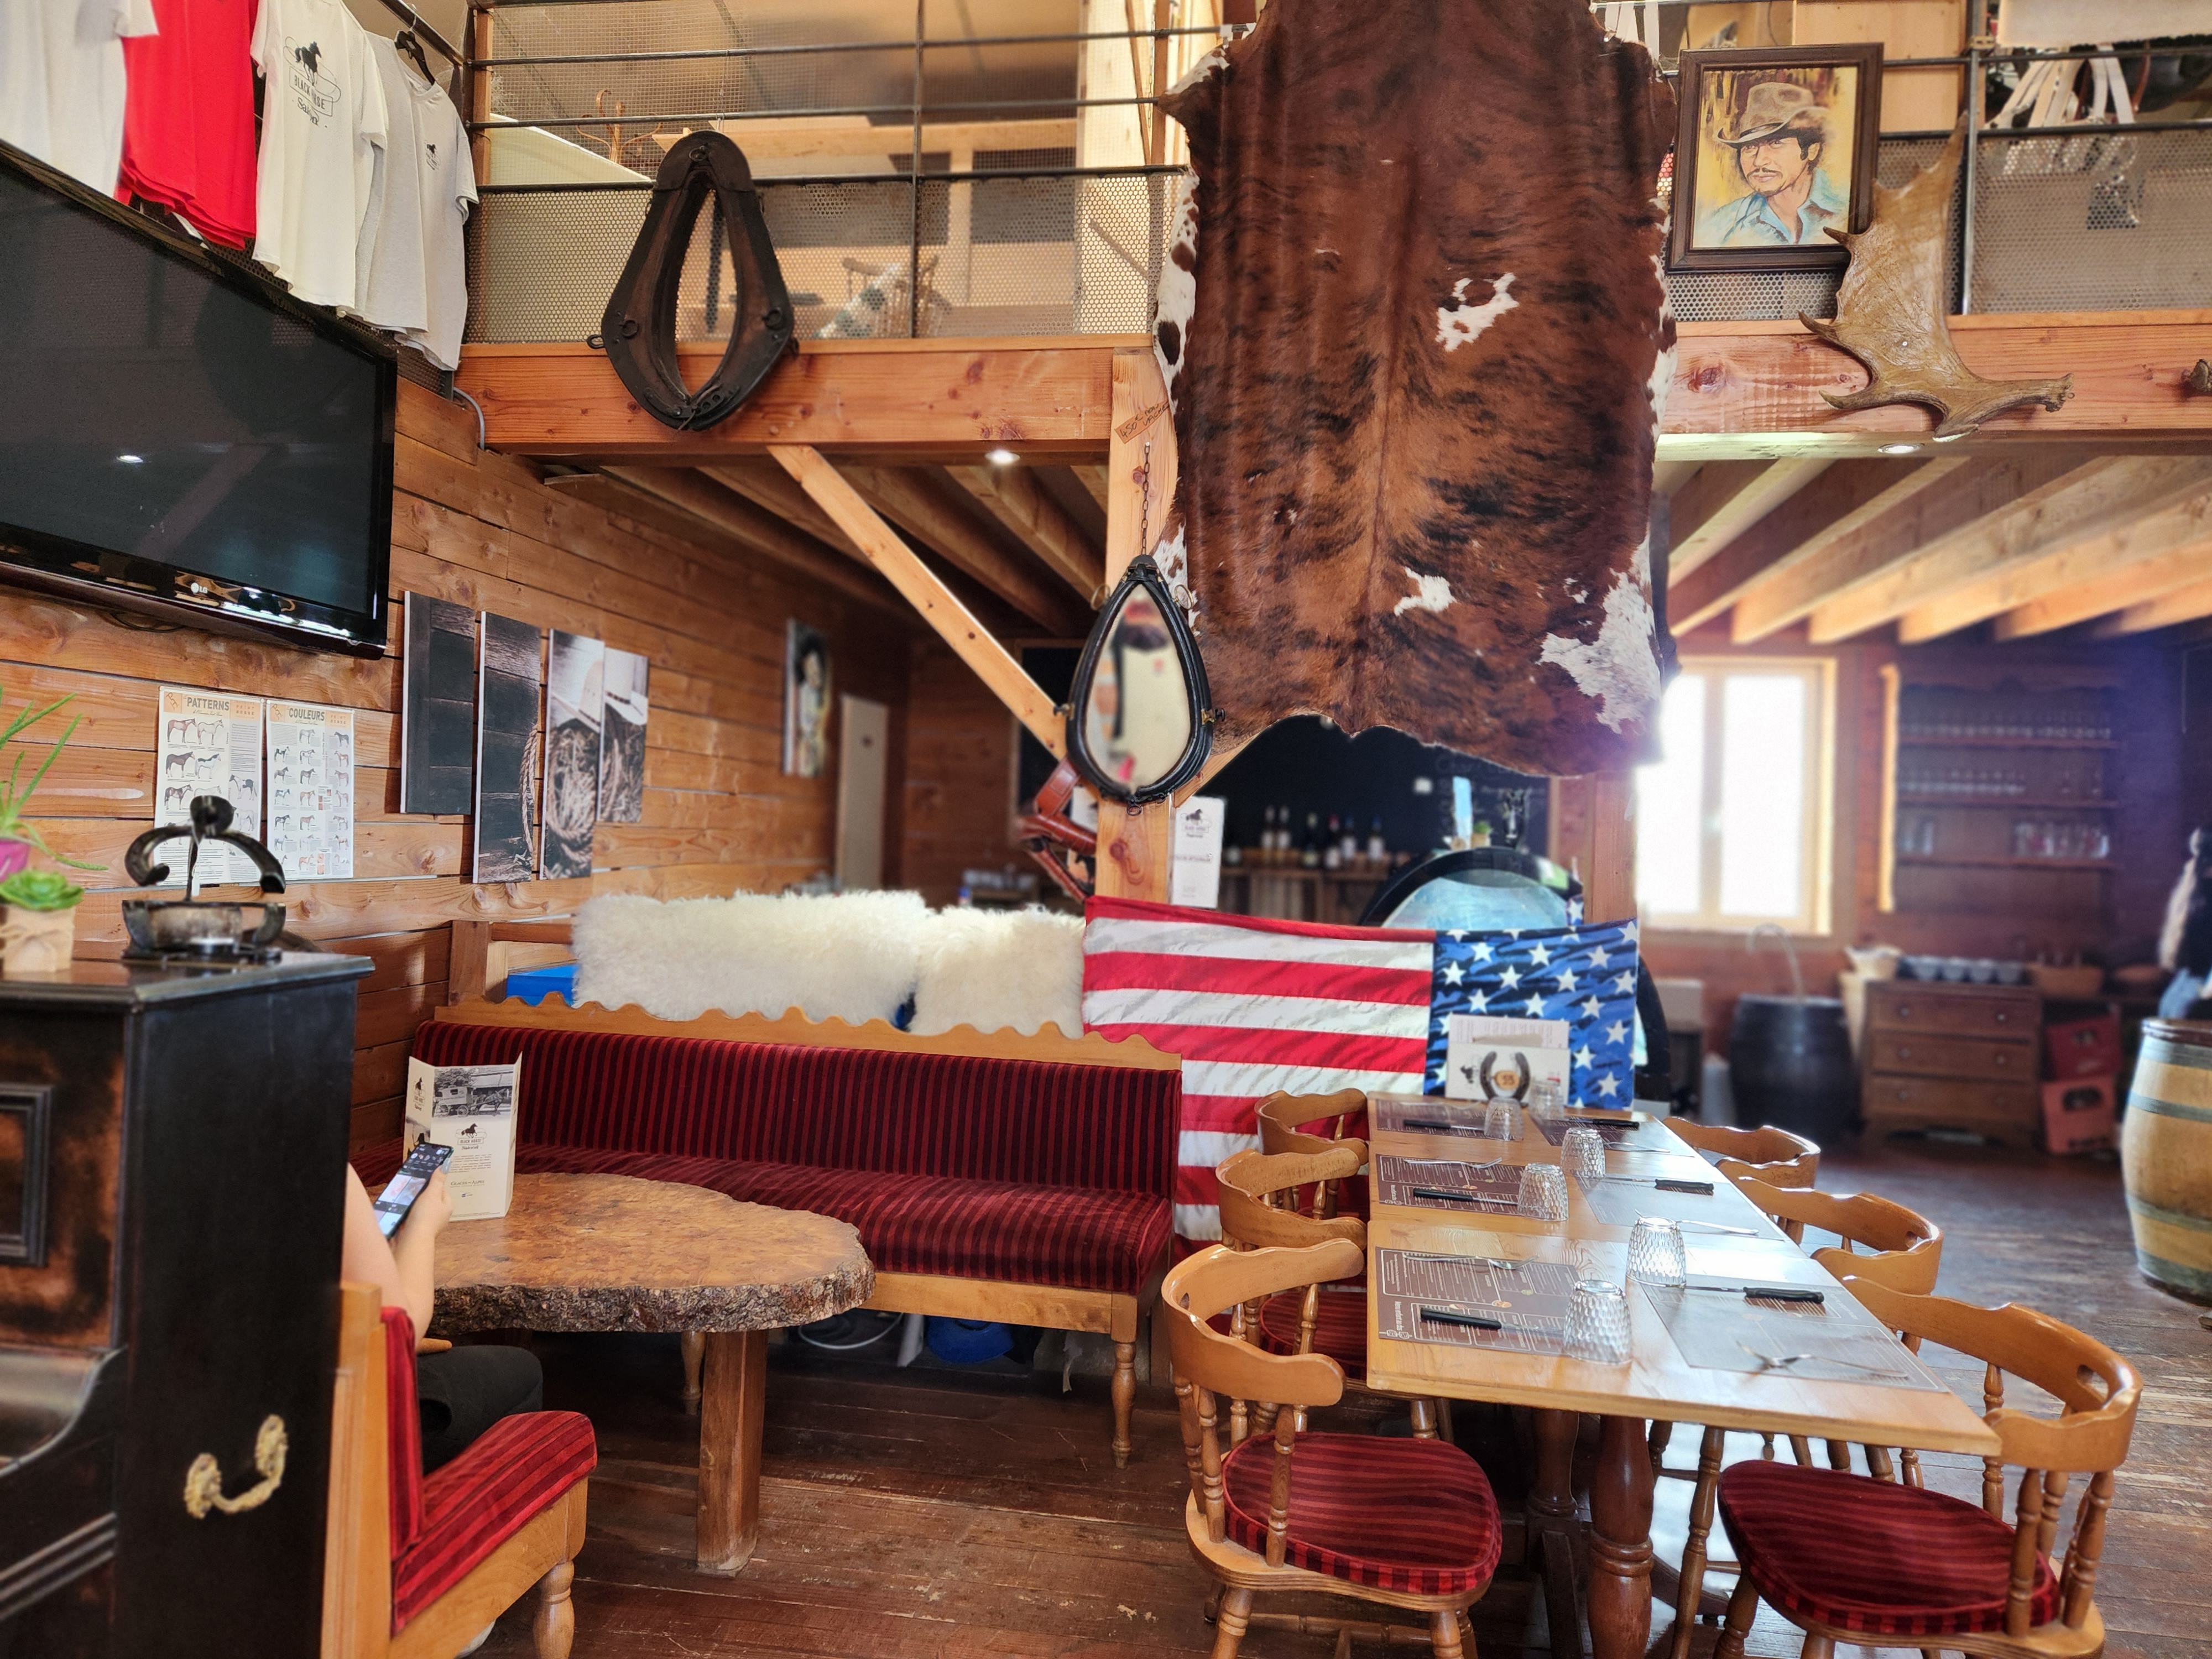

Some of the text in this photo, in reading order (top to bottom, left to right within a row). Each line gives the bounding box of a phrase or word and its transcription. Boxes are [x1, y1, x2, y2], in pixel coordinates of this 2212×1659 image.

[294, 75, 325, 110] BLACK RSE
[187, 697, 229, 711] PATTERNS
[289, 707, 325, 722] COULEURS
